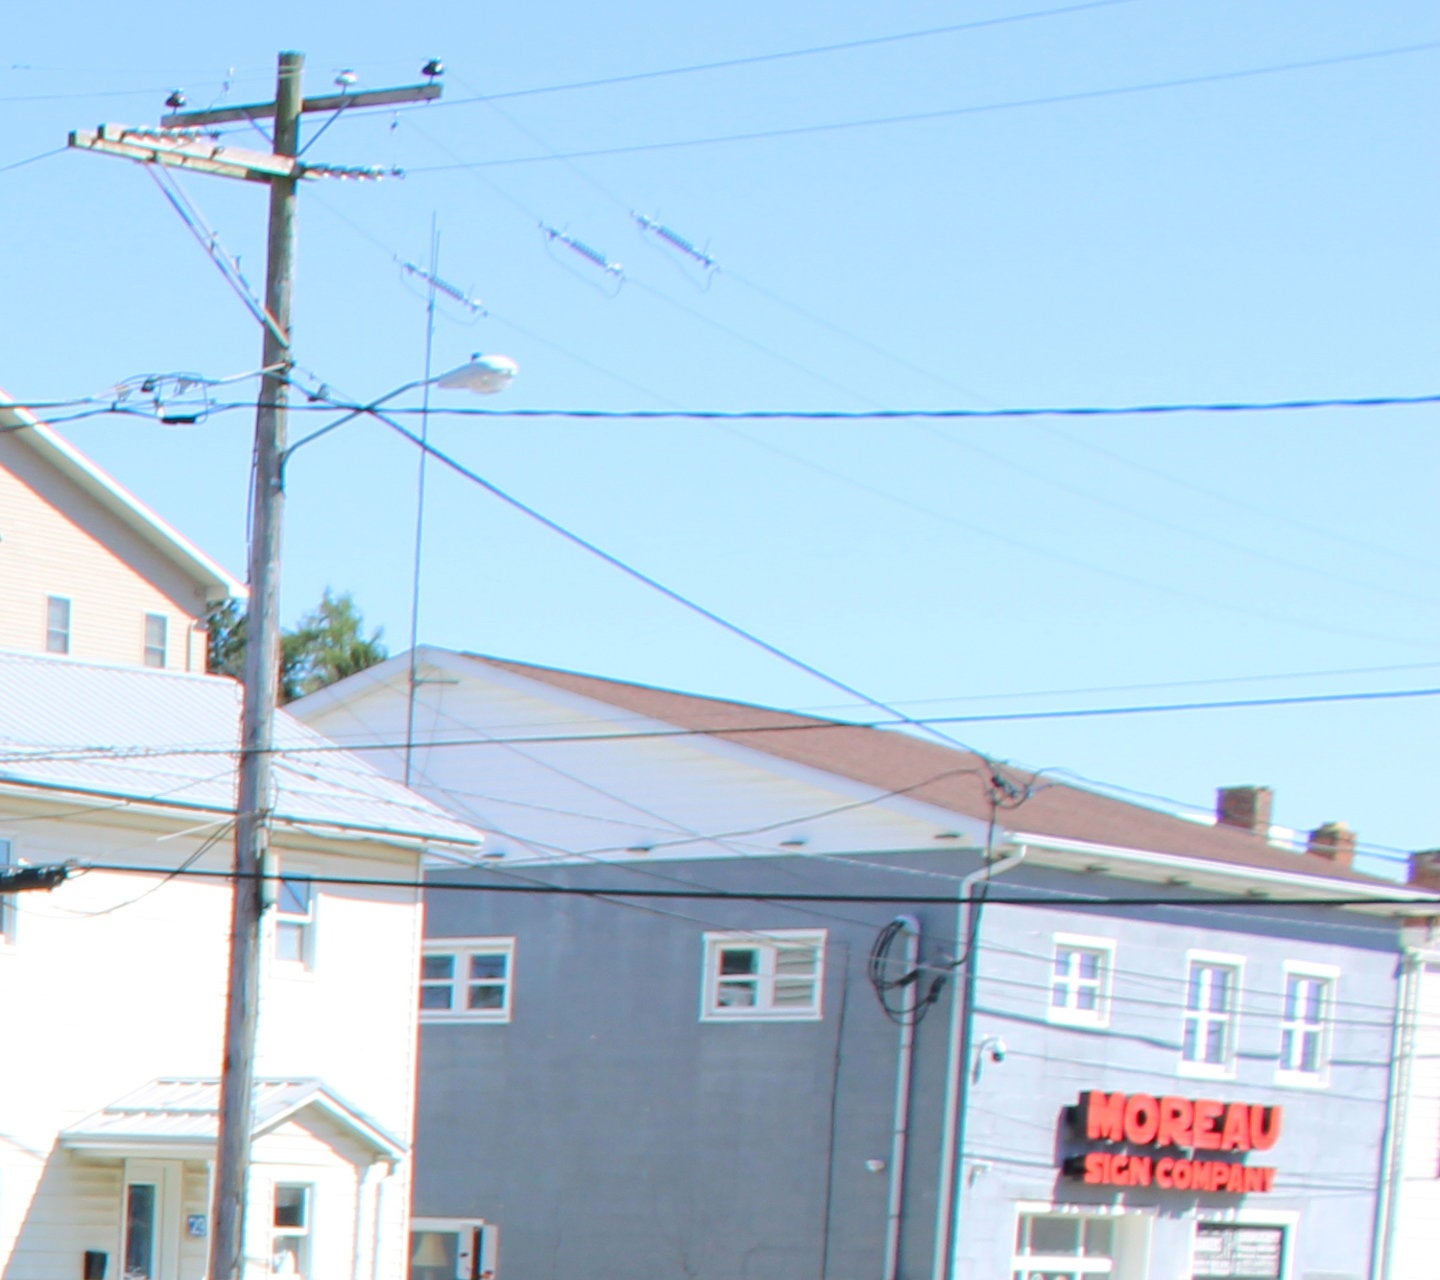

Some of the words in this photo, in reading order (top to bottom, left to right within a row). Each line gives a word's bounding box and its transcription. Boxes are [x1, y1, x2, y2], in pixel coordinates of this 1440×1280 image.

[1086, 1088, 1284, 1152] MOREAU
[1083, 1151, 1153, 1187] SIGN
[1154, 1156, 1279, 1194] COMPANY
